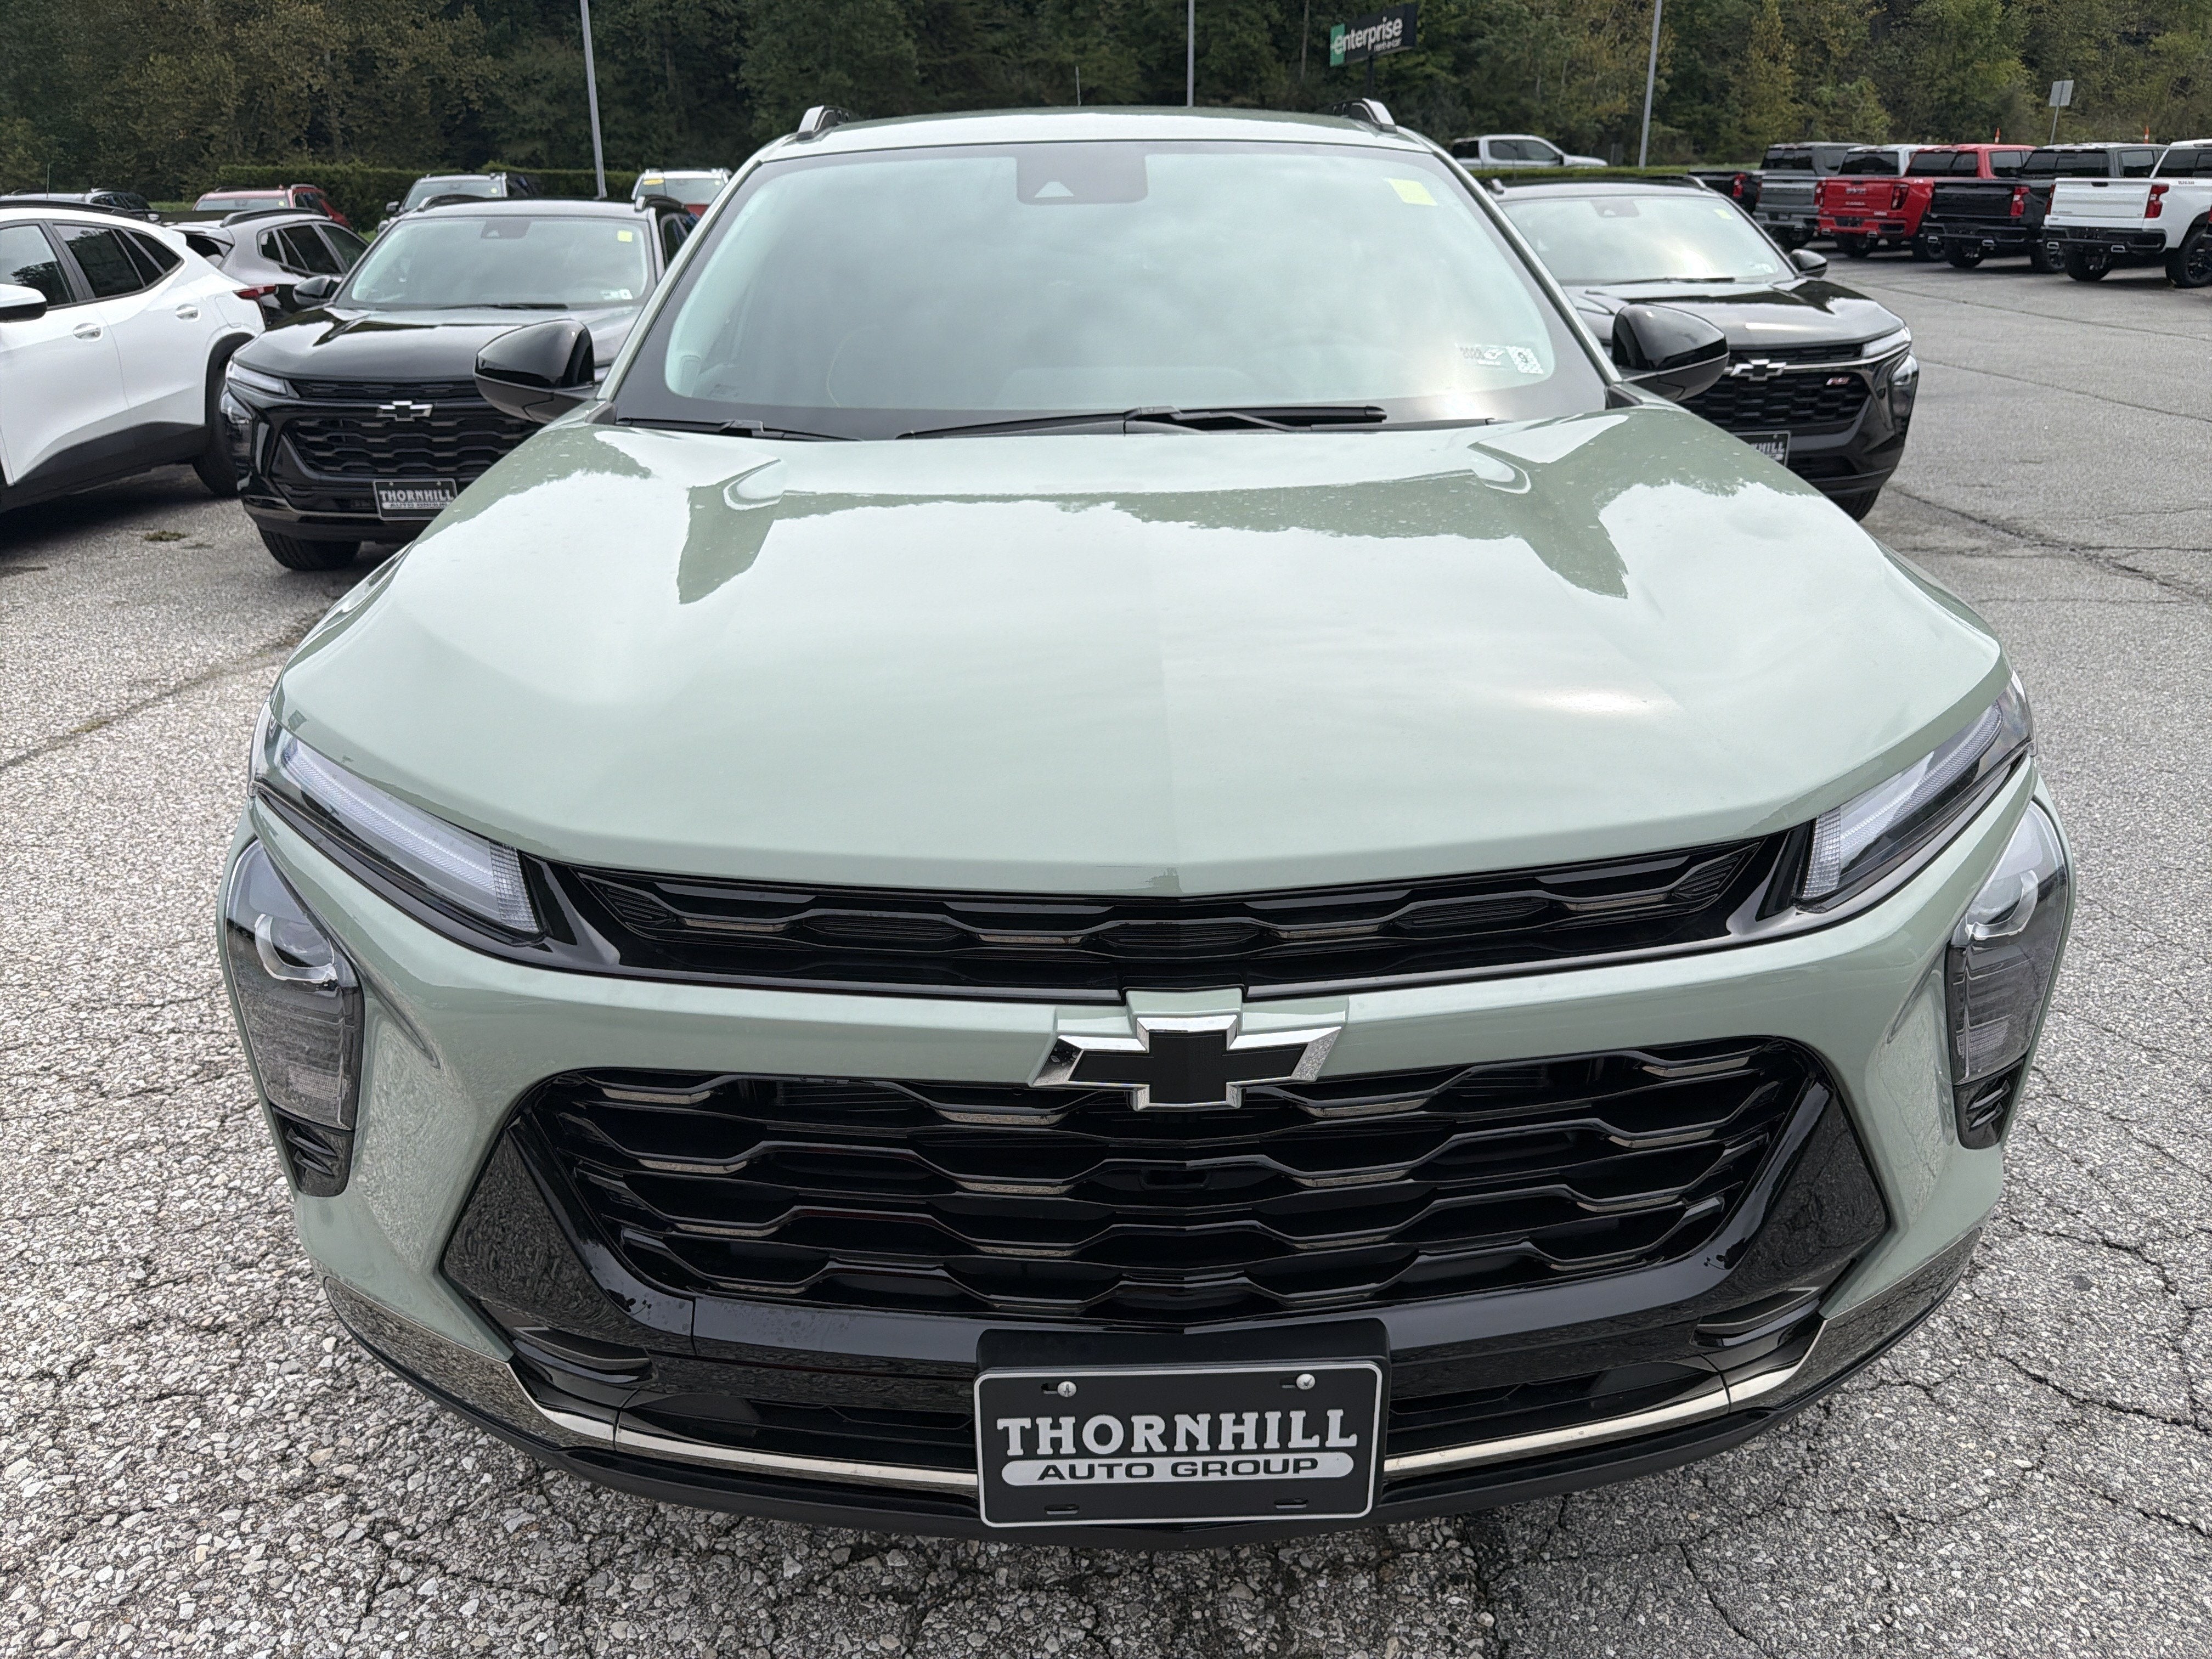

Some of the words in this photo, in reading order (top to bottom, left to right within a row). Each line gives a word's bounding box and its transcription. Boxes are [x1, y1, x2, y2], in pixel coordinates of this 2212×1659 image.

[1330, 16, 1403, 55] enterprise
[379, 489, 454, 502] THORNHILL
[997, 1409, 1357, 1456] THORNHILL
[1037, 1463, 1154, 1480] AUTO
[1171, 1458, 1318, 1477] GROUP
